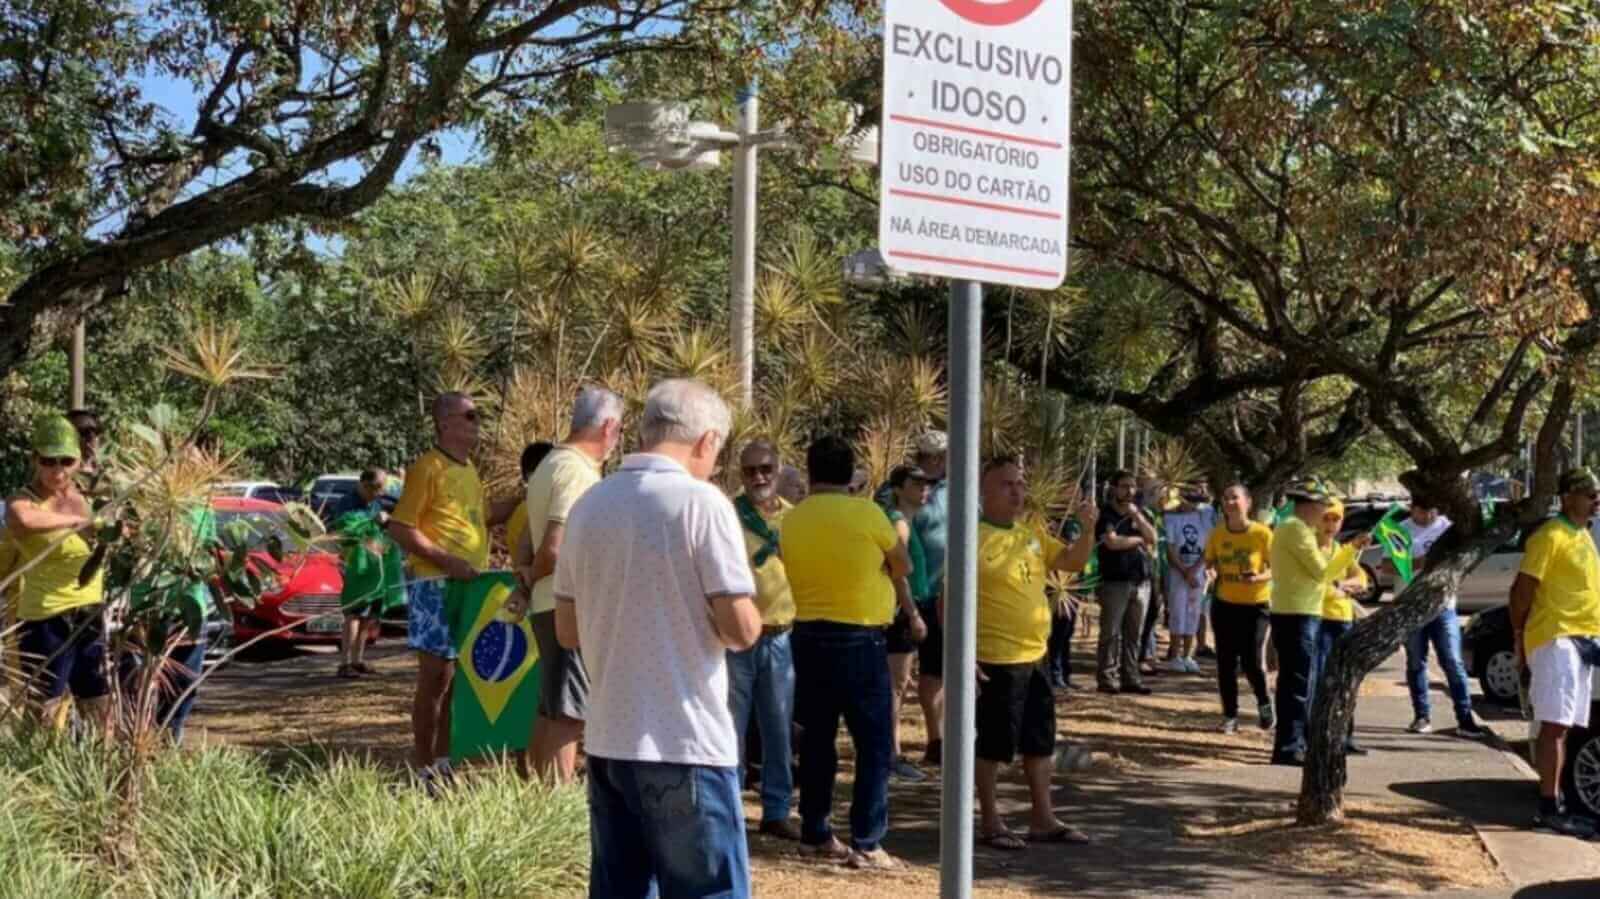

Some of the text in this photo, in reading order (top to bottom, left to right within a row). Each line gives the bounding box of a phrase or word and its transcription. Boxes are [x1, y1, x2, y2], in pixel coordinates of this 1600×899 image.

[892, 24, 1063, 85] EXCLUSIVO
[931, 80, 1026, 125] IDOSO
[913, 131, 1039, 169] OBRIGATÓRIO
[898, 163, 1050, 203] USO DO CARTÃO
[890, 216, 1062, 256] NA ÁREA DEMARCADA
